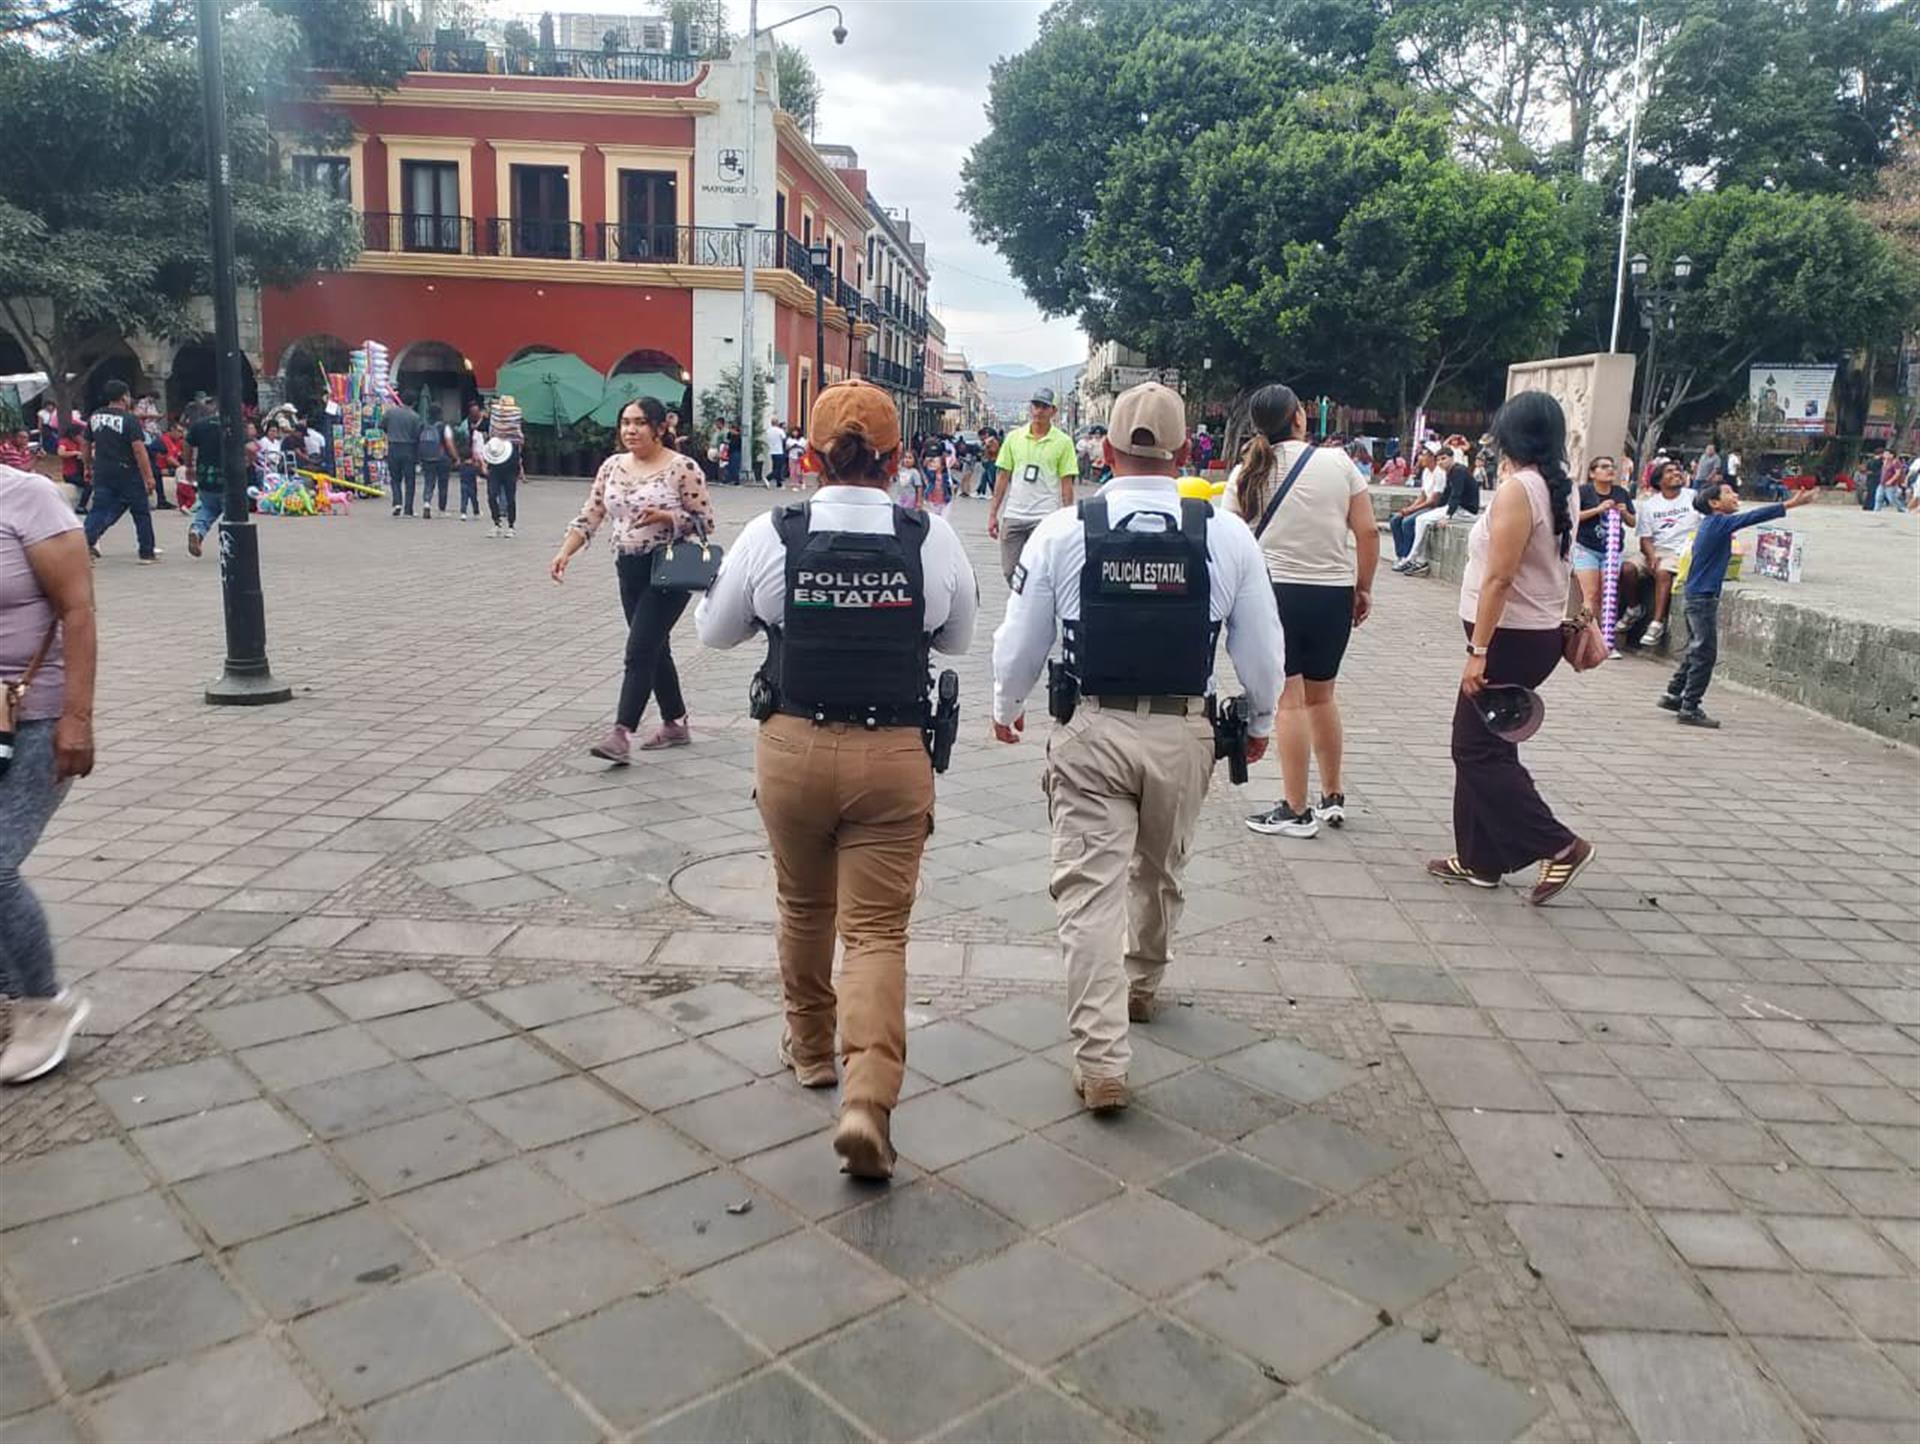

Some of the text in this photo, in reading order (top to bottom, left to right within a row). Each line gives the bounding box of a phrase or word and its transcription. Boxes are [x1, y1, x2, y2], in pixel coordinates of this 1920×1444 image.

[701, 185, 759, 196] MAYORDOO
[797, 571, 908, 586] POLICIA
[1102, 560, 1186, 584] POLICÍA ESTATAL
[793, 588, 913, 604] ESTATAL
